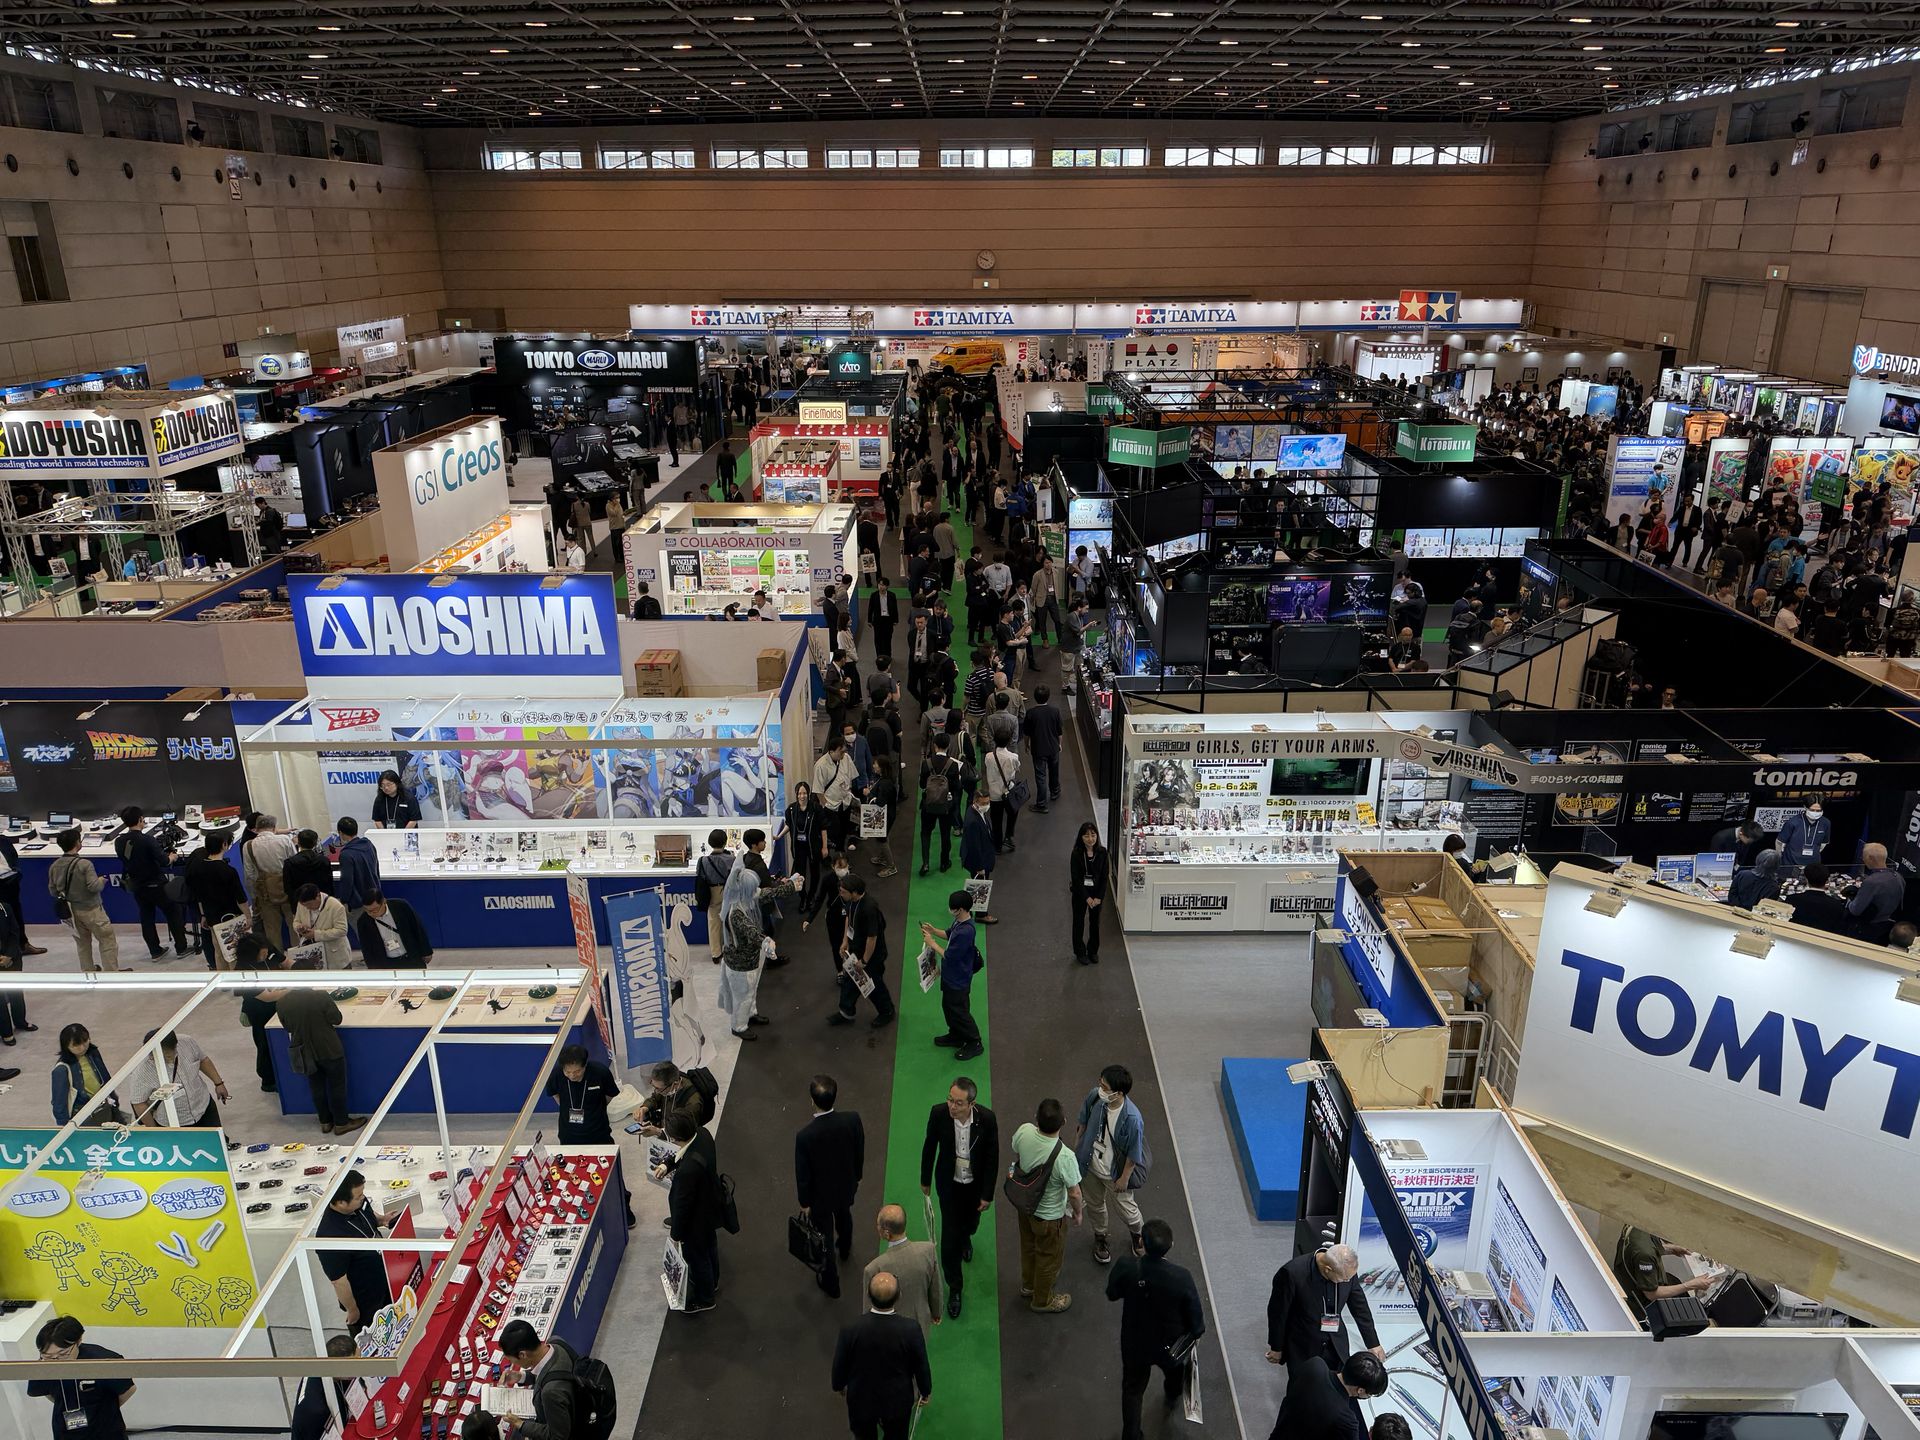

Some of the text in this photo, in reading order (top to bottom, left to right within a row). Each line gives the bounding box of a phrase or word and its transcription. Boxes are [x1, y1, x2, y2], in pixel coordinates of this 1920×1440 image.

[946, 312, 1014, 324] TAMIYA
[1168, 309, 1237, 322] TAMIYA
[524, 351, 668, 369] TOKYO MARUI MARUI
[1019, 342, 1027, 362] EVO.
[300, 357, 310, 369] JOE
[839, 361, 860, 372] KATO
[1125, 359, 1178, 368] PLATZ
[804, 408, 842, 419] FineMolds
[166, 401, 237, 449] DOYUSHA
[4, 419, 148, 456] DOYUSHA
[160, 453, 180, 464] Leading
[179, 450, 187, 458] the
[186, 447, 199, 457] world
[204, 443, 216, 453] model
[28, 460, 39, 468] the
[41, 460, 63, 468] world
[65, 460, 72, 468] in
[75, 459, 98, 468] model
[415, 440, 501, 506] GSI Creos
[680, 537, 785, 548] COLLABORATION
[833, 534, 844, 561] NEW
[373, 596, 606, 656] AOSHIMA
[324, 709, 376, 719] マクロス
[86, 731, 150, 747] BACK
[1196, 739, 1380, 755] GIRLS, GET YOUR ARMS.
[105, 747, 158, 760] FUTURE
[1753, 767, 1858, 786] tomica
[1268, 809, 1351, 821] 一般販売開始
[1635, 803, 1647, 812] 64
[500, 896, 555, 909] AOSHIMA
[1353, 895, 1383, 955] TOMYTEC
[1561, 948, 1920, 1139] TOMYT
[83, 1144, 219, 1168] 全ての人へ
[151, 1185, 226, 1206] 少ないパーツで
[1414, 1205, 1456, 1213] ANNIVERSARY
